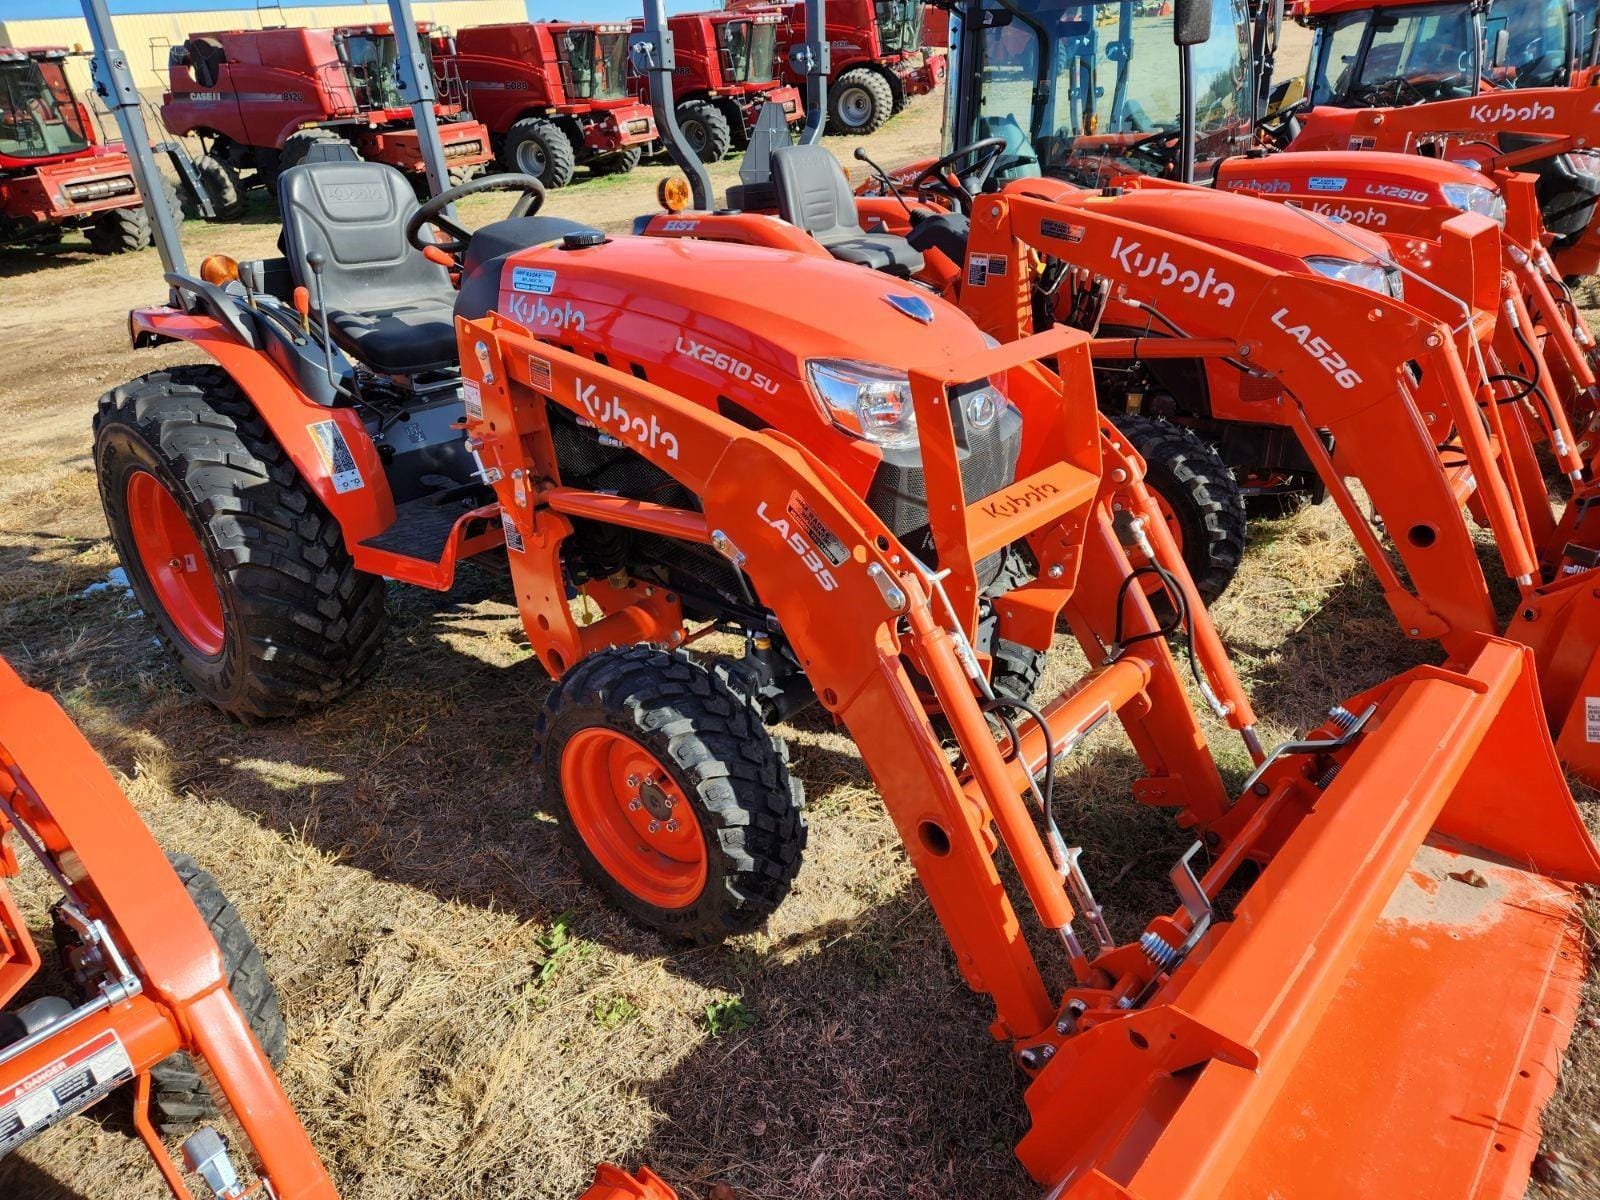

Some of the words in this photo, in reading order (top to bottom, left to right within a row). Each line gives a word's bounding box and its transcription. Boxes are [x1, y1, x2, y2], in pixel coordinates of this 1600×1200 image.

[1470, 101, 1555, 123] Kubota
[1365, 184, 1428, 202] LX2610
[1110, 236, 1235, 308] Kubota
[509, 293, 585, 332] Kubota
[675, 336, 752, 380] LX2610
[750, 372, 780, 395] SU
[1271, 307, 1363, 389] LA526
[575, 377, 679, 461] Kubota
[981, 484, 1060, 518] Kubota
[757, 501, 838, 591] LA535
[23, 1061, 68, 1090] DANGER
